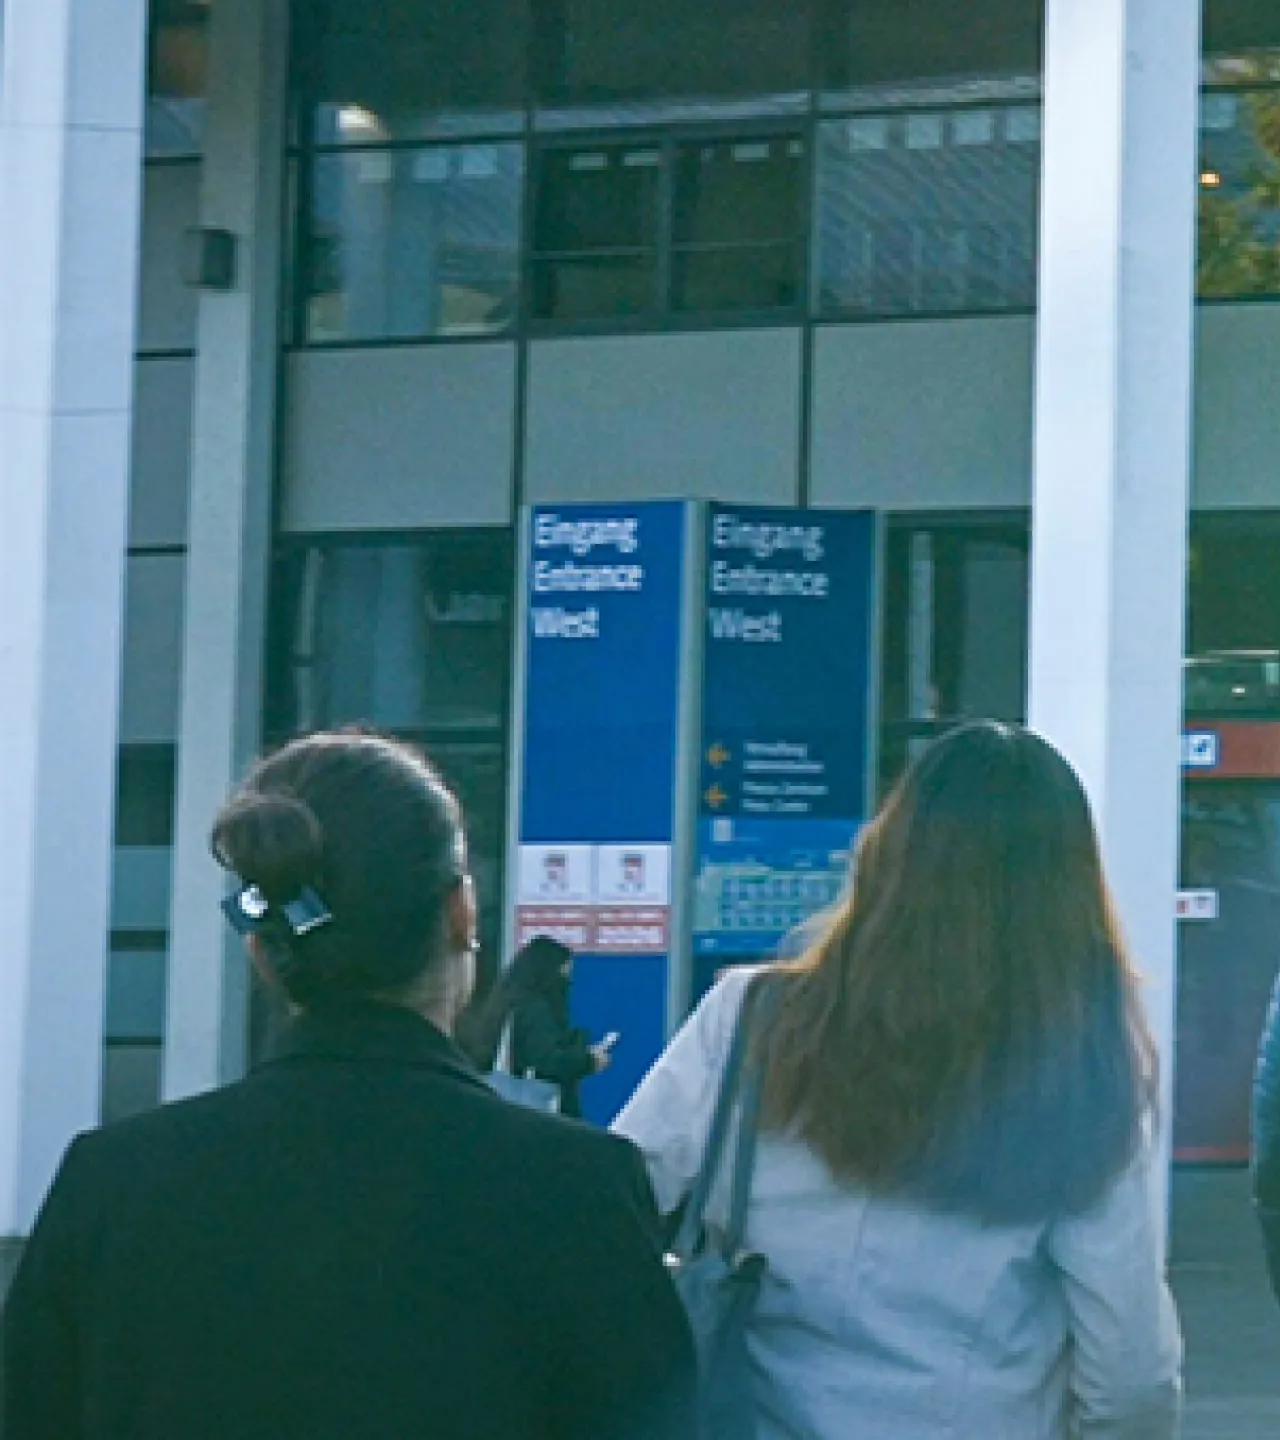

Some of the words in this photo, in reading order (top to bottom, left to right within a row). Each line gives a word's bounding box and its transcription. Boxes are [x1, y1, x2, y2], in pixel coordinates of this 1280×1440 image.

[534, 513, 639, 556] Eingang
[712, 513, 826, 560] Eingang
[534, 560, 643, 592] Entrance
[712, 560, 829, 597] Entrance
[531, 606, 600, 638] West
[709, 607, 783, 642] West
